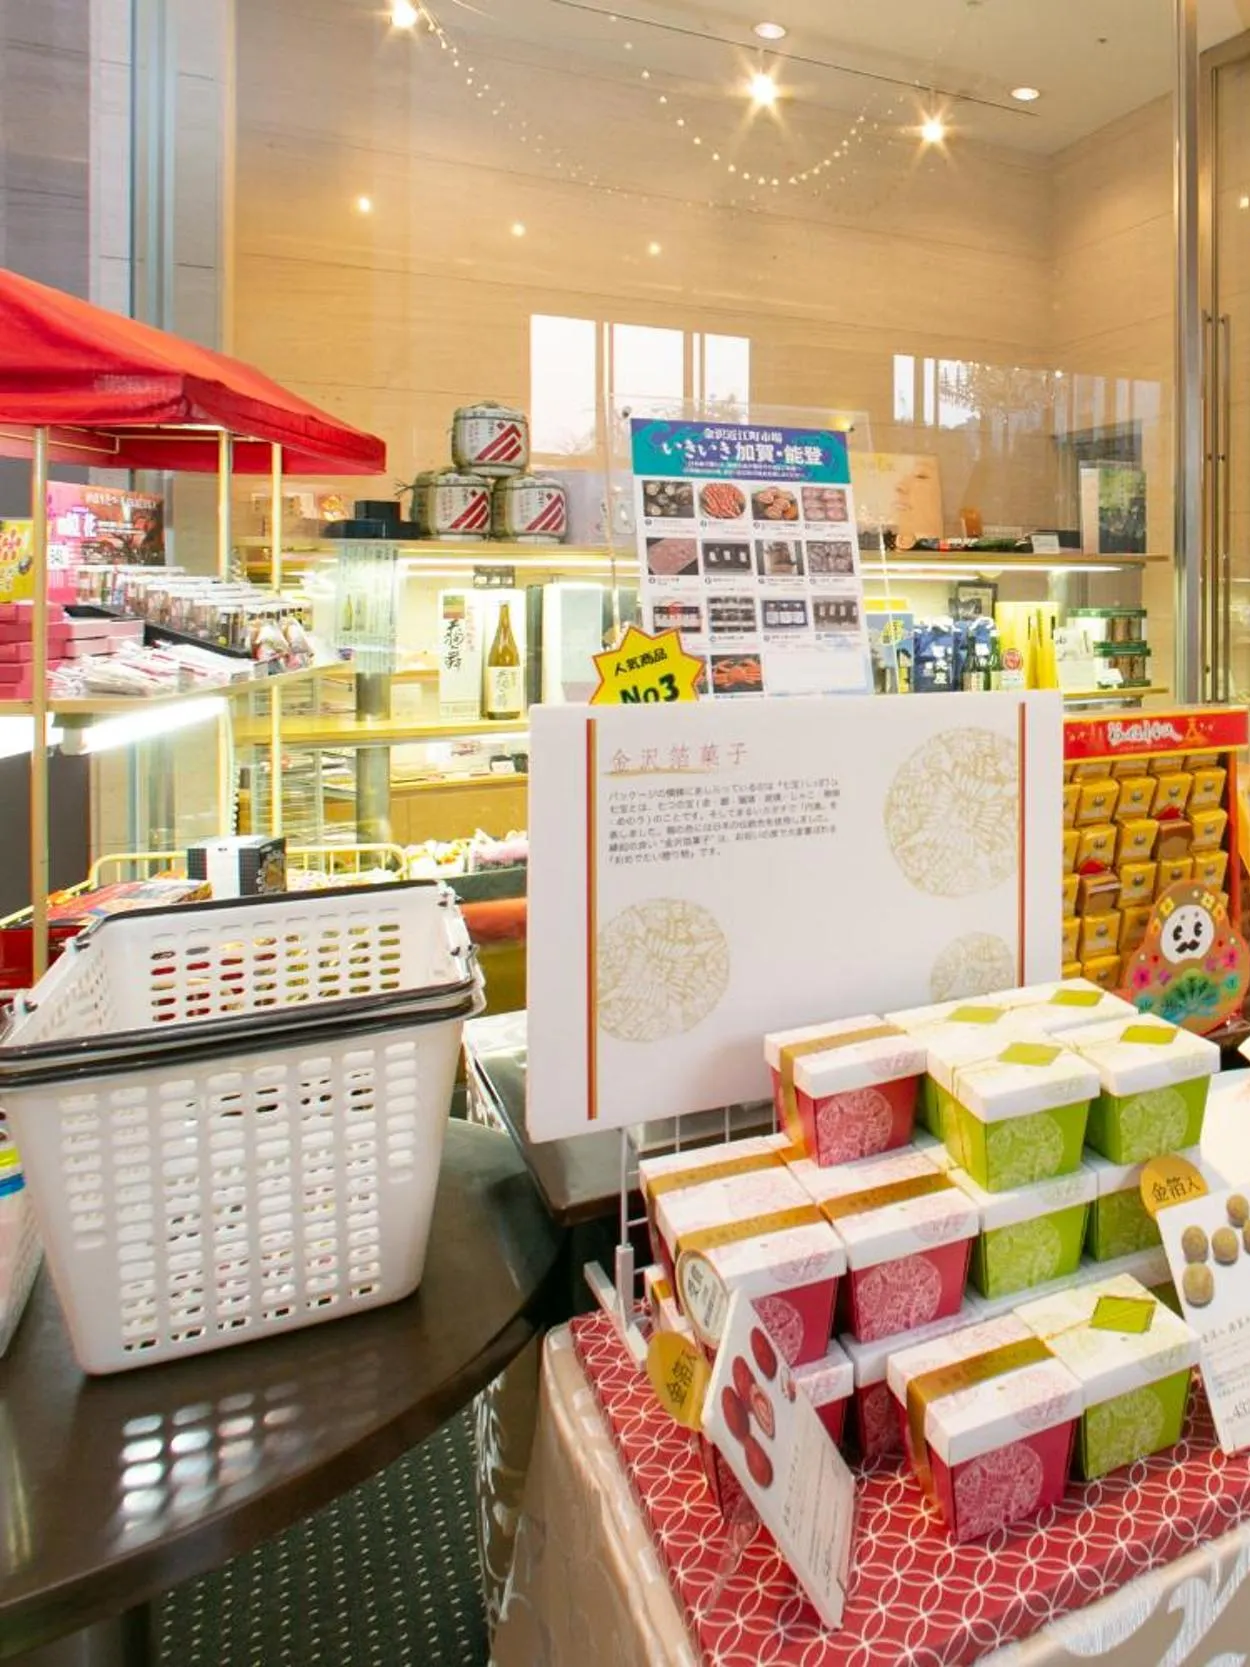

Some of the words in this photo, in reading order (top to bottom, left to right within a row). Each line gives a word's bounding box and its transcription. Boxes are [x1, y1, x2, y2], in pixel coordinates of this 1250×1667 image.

[661, 439, 824, 466] いきいき加賀・能登
[614, 647, 668, 677] 人気商品
[620, 672, 680, 704] No3
[611, 741, 748, 772] 金沢箔菓子
[1151, 1175, 1202, 1202] 金箔入
